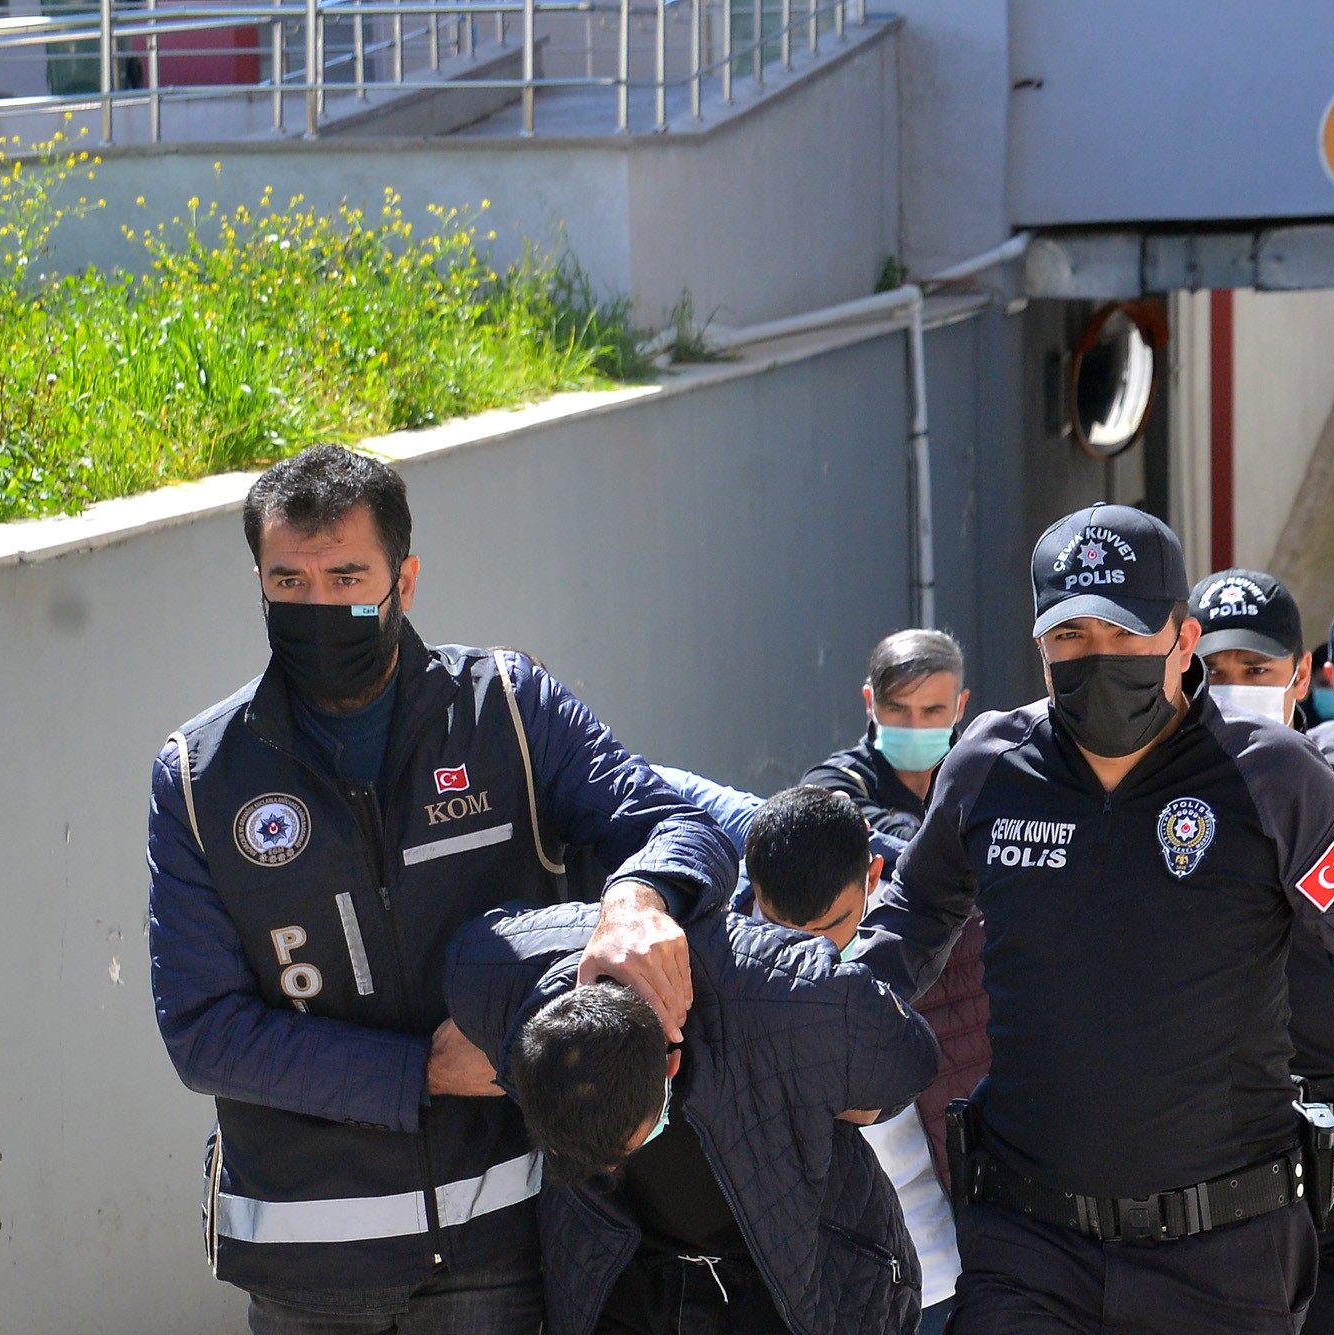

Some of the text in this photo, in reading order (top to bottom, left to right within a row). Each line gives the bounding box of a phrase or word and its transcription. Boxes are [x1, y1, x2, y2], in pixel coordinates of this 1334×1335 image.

[1085, 527, 1137, 562] KUVVET
[423, 790, 492, 826] KOM
[1023, 820, 1076, 845] KUVVET
